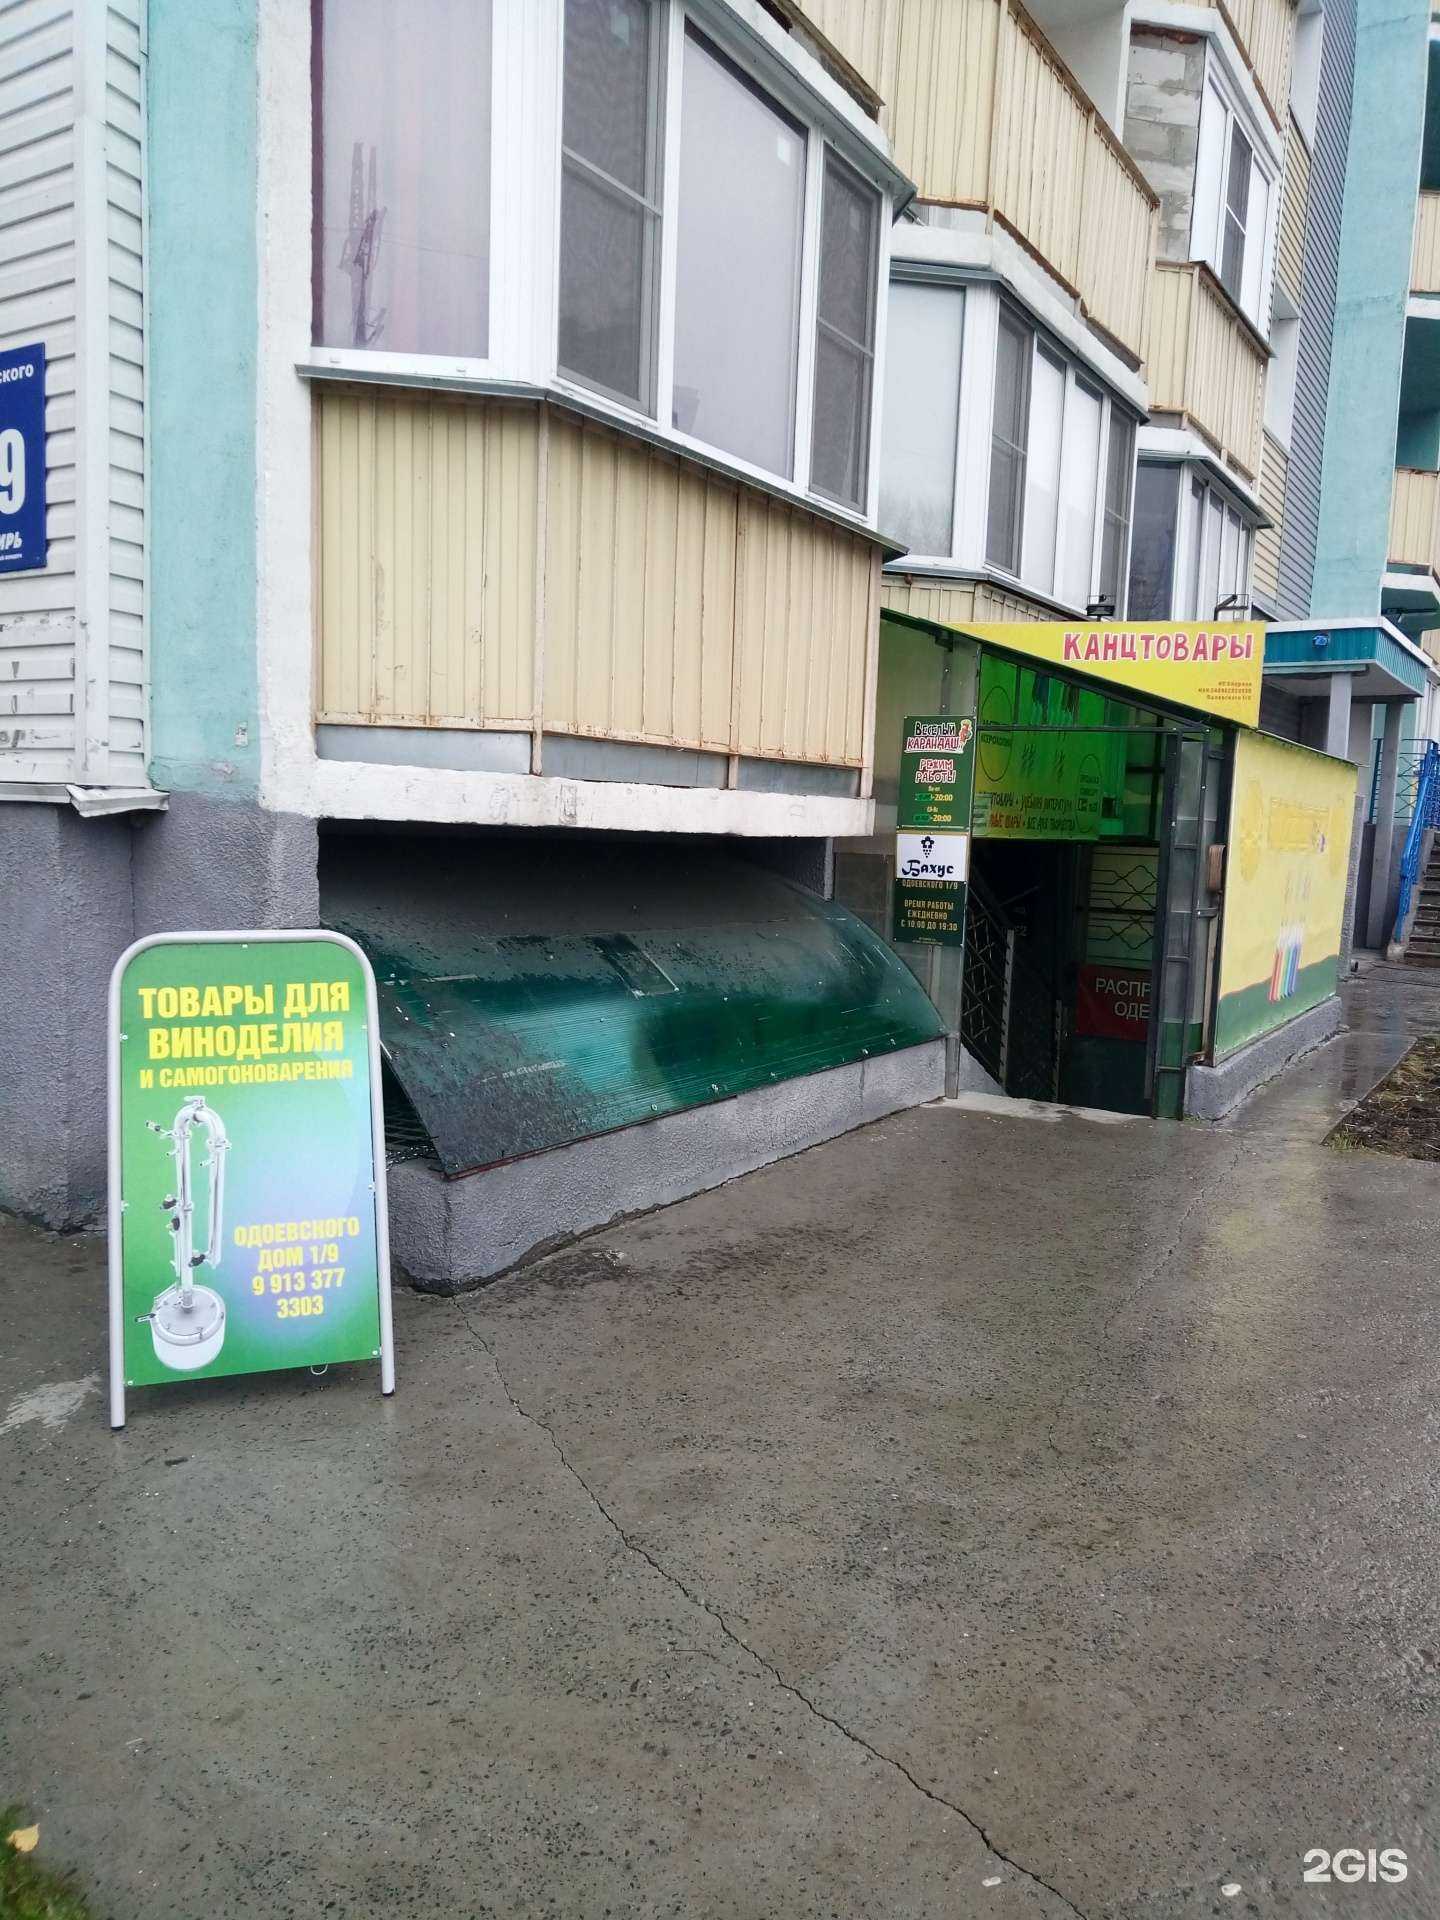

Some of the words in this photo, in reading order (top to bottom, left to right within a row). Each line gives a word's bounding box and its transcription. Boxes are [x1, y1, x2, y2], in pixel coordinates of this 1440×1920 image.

[1063, 632, 1253, 662] КАНЦТОВАРЫ
[907, 737, 960, 750] КАРАНДАШ
[915, 770, 956, 784] РАБОТЫ
[920, 759, 954, 770] РЕЖИМ
[904, 899, 926, 909] ВРЕМЯ
[928, 901, 955, 911] РАБОТЫ
[907, 909, 948, 920] ЕЖЕДНЕВНО
[900, 919, 906, 928] С
[927, 921, 937, 930] ДО
[138, 984, 274, 1019] ТОВАРЫ
[283, 981, 350, 1018] ДЛЯ
[148, 1021, 344, 1061] ВИНОДЕЛИЯ
[139, 1069, 154, 1089] И
[159, 1060, 353, 1088] САМОГОНОВАРЕНИЯ
[234, 1216, 360, 1249] ОДОЕВСКОГО
[258, 1246, 303, 1273] ДОМ
[309, 1243, 339, 1264] 1/9
[252, 1275, 265, 1296] 9
[270, 1271, 306, 1294] 913
[311, 1267, 345, 1290] 377
[277, 1295, 324, 1319] 3303
